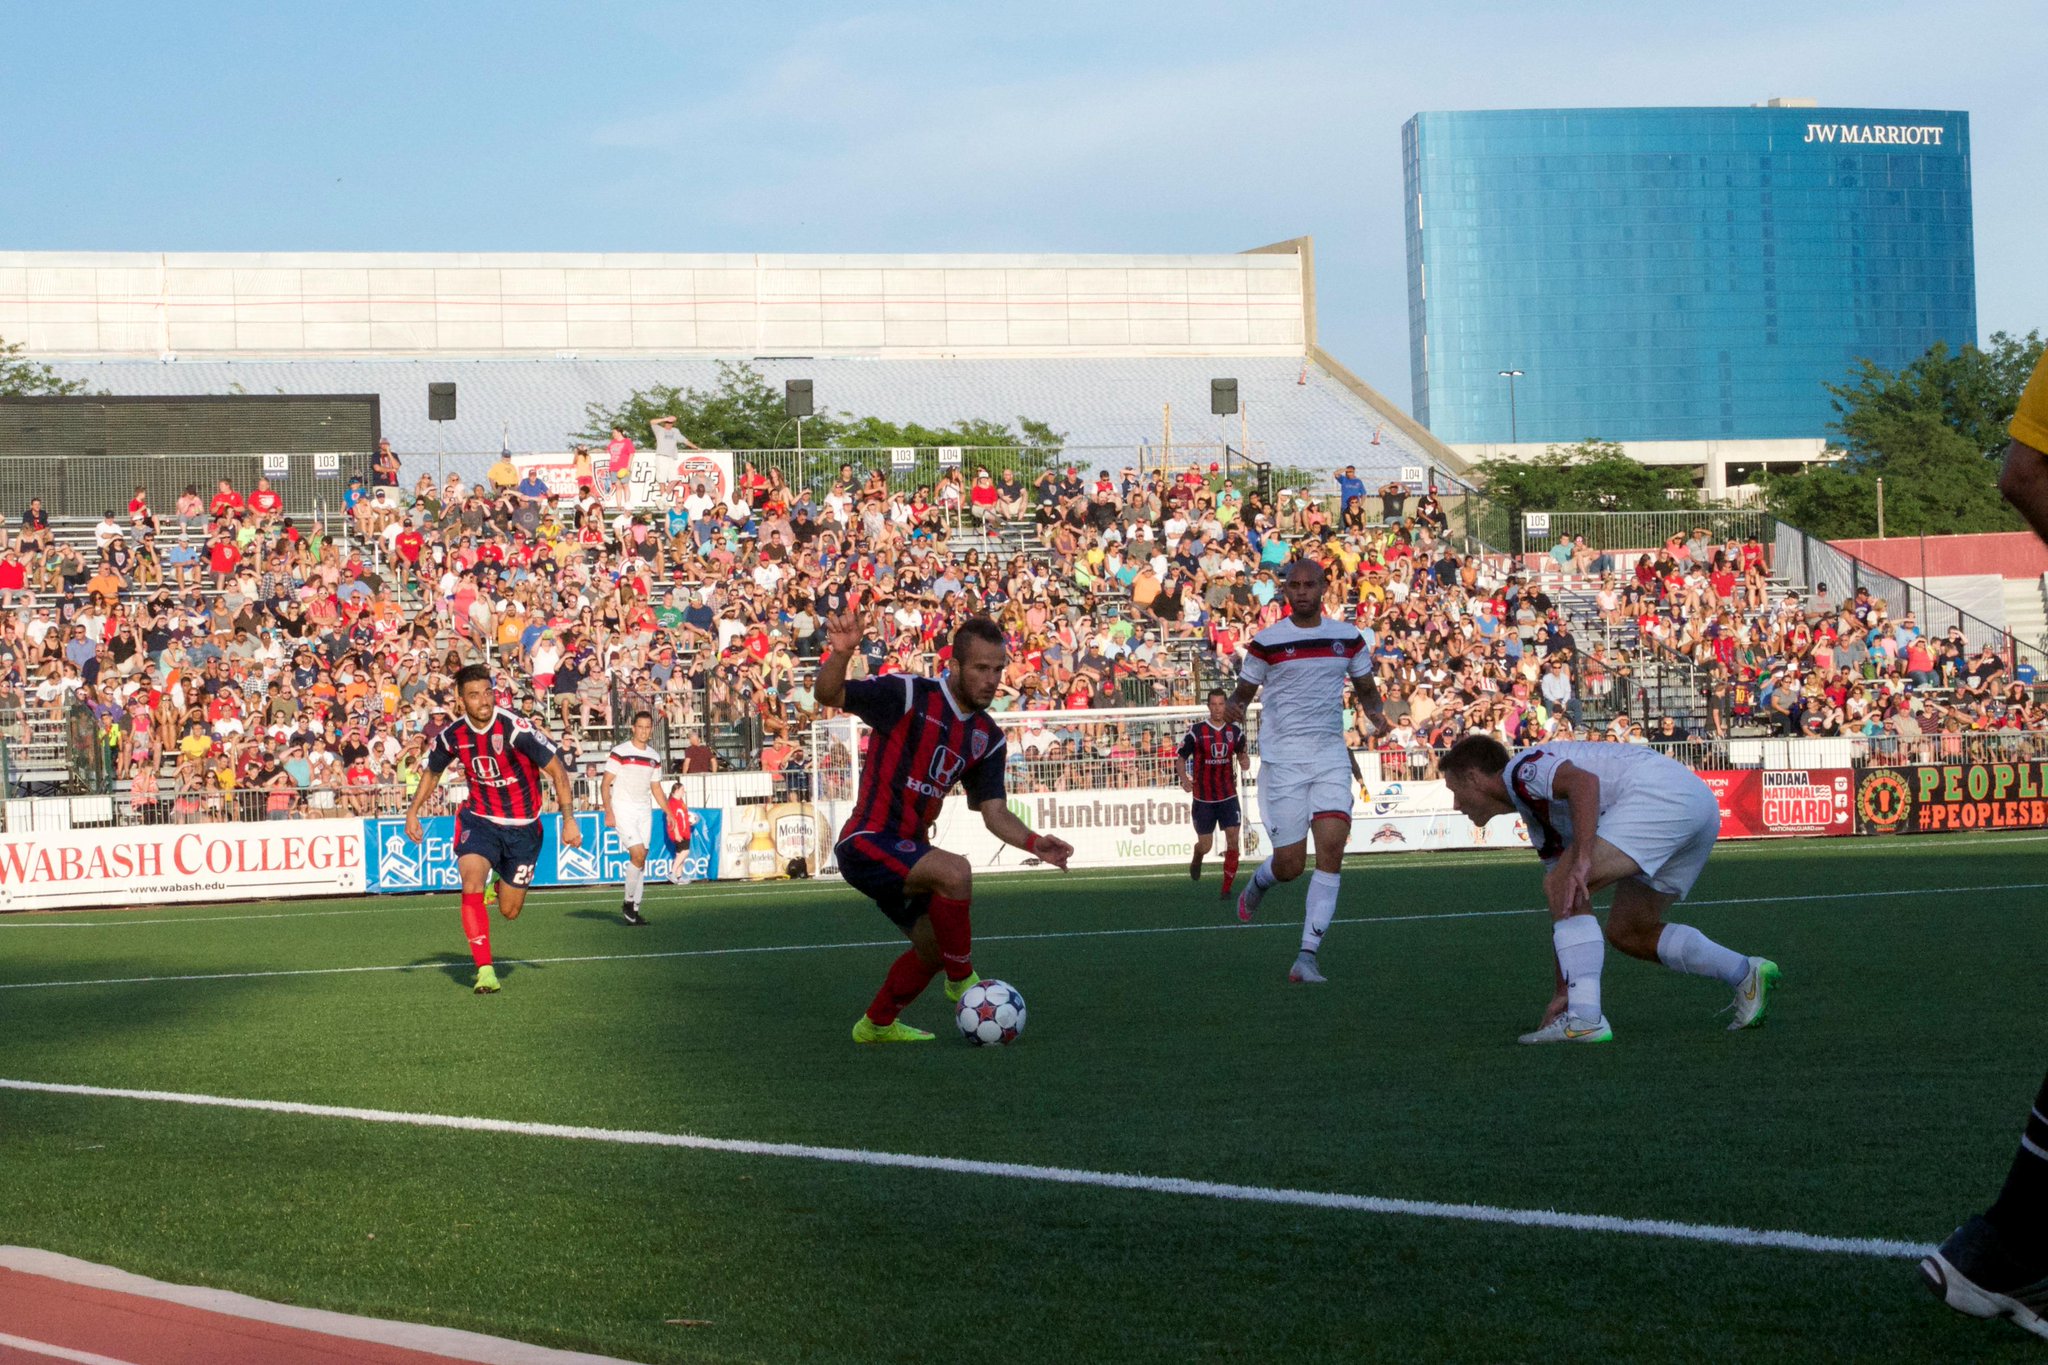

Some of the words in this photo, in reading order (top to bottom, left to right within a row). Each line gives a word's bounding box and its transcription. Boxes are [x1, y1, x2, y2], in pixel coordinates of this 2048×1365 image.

[1804, 124, 1838, 143] JW
[1840, 125, 1943, 145] MARRIOTT
[319, 455, 335, 467] 103
[896, 449, 911, 461] 103
[942, 448, 958, 460] 104
[268, 456, 285, 468] 102
[631, 462, 656, 483] th
[1404, 468, 1420, 480] 104
[1530, 515, 1546, 527] 105
[1764, 772, 1808, 786] INDIANA
[906, 776, 945, 798] HON
[1764, 786, 1816, 799] NATIONAL
[1037, 798, 1190, 834] Huntington
[1764, 800, 1830, 825] GUARD
[1919, 800, 2048, 832] #PEOPLESB
[780, 823, 813, 838] Modelo
[427, 838, 454, 861] Eri
[1116, 839, 1192, 858] Welcome
[0, 841, 164, 885] WABASH
[173, 833, 360, 876] COLLEGE
[129, 880, 225, 895] www.wabash.edu
